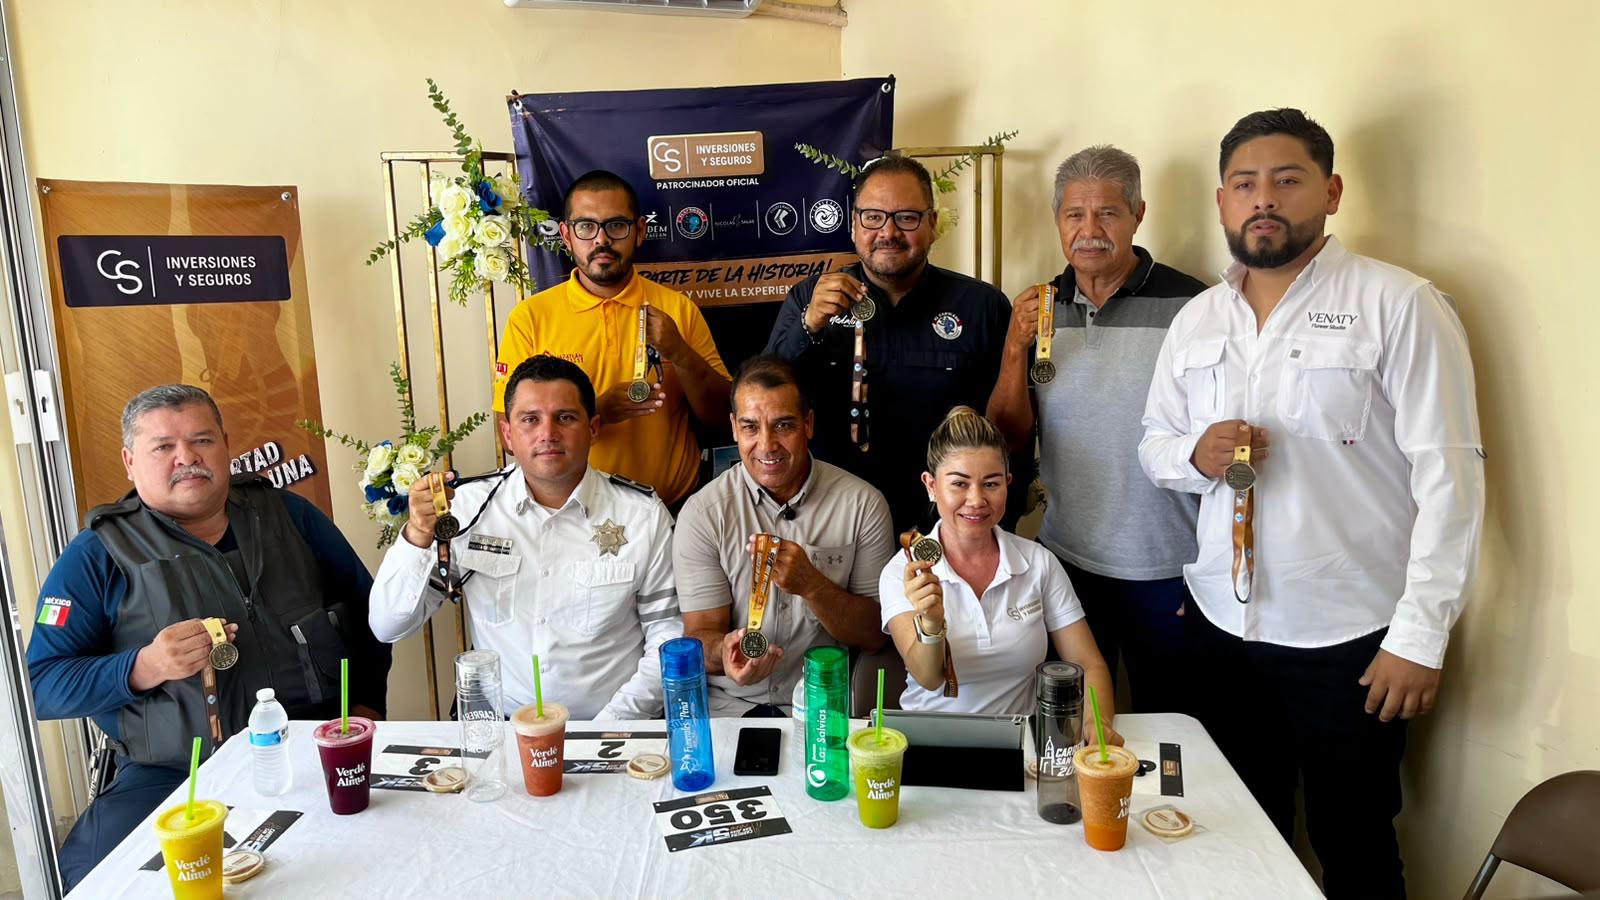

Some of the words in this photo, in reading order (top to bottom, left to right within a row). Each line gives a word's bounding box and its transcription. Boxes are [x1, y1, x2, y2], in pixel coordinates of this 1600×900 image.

[696, 142, 756, 154] INVERSIONES
[701, 157, 707, 166] Y
[709, 155, 752, 166] SEGUROS
[656, 179, 724, 190] PATROCINADOR
[726, 178, 759, 187] OFICIAL
[647, 225, 667, 233] DEM
[166, 255, 256, 270] INVERSIONES
[696, 268, 722, 284] DE
[724, 265, 743, 283] LA
[747, 258, 833, 283] HISTORIA!
[174, 274, 184, 287] Y
[188, 273, 252, 287] SEGUROS
[685, 291, 694, 299] Y
[695, 289, 721, 299] VIVE
[725, 288, 738, 297] LA
[741, 285, 793, 297] EXPERIEN
[1308, 312, 1358, 325] VENATY
[230, 441, 280, 475] RTAD
[267, 454, 314, 488] UNA
[44, 597, 71, 606] MÉXICO
[816, 709, 826, 743] Salvias
[529, 746, 558, 759] Verdé
[597, 741, 625, 759] 2
[815, 747, 826, 763] Las
[408, 757, 441, 775] 3
[531, 756, 558, 769] Alma
[335, 763, 365, 777] Verdé
[336, 773, 365, 787] Alma
[866, 778, 895, 791] Verdé
[867, 788, 895, 800] Alma
[670, 799, 767, 830] 350
[174, 854, 210, 871] Verdé
[177, 867, 212, 883] Alma
